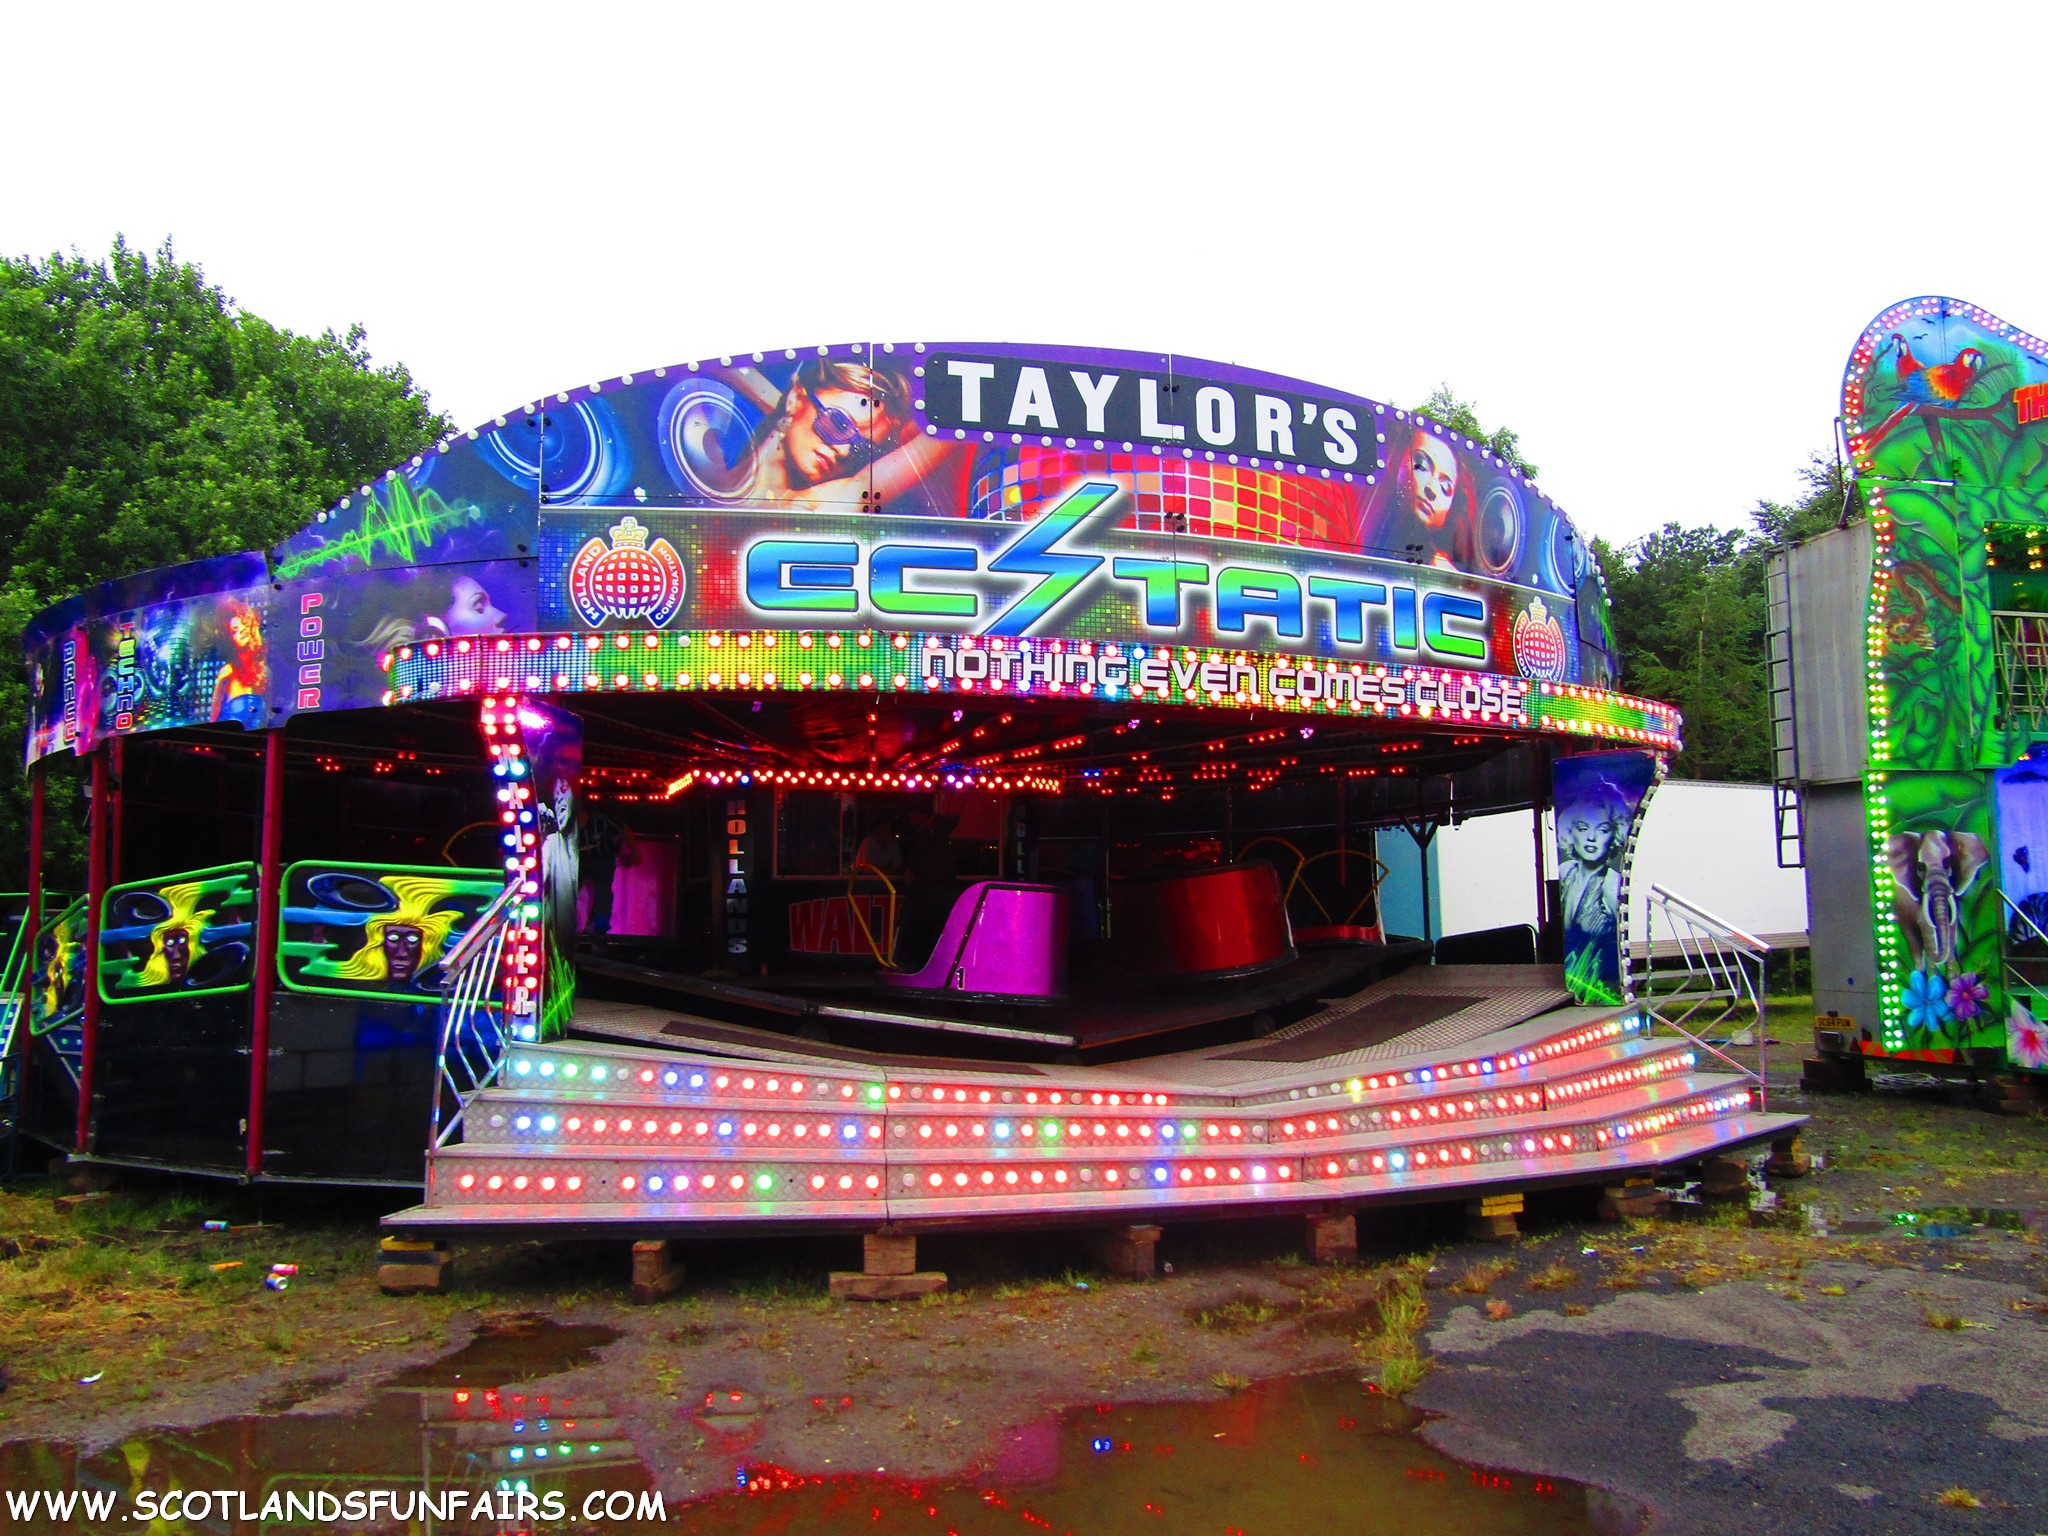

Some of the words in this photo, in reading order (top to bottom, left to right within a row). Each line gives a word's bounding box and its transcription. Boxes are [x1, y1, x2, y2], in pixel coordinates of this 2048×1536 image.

[946, 360, 1359, 466] TAYLOR'S
[576, 545, 601, 621] HOLLAND
[655, 546, 679, 621] CORPORATION
[115, 621, 136, 730] TECHNO
[297, 592, 325, 709] POWER
[921, 647, 1128, 685] NOTHING
[1138, 657, 1259, 694] EVEN
[1267, 668, 1406, 705] COMES
[1414, 678, 1522, 715] CLOSE
[1516, 616, 1531, 676] HOLLAND
[725, 800, 749, 954] HOLLANDS
